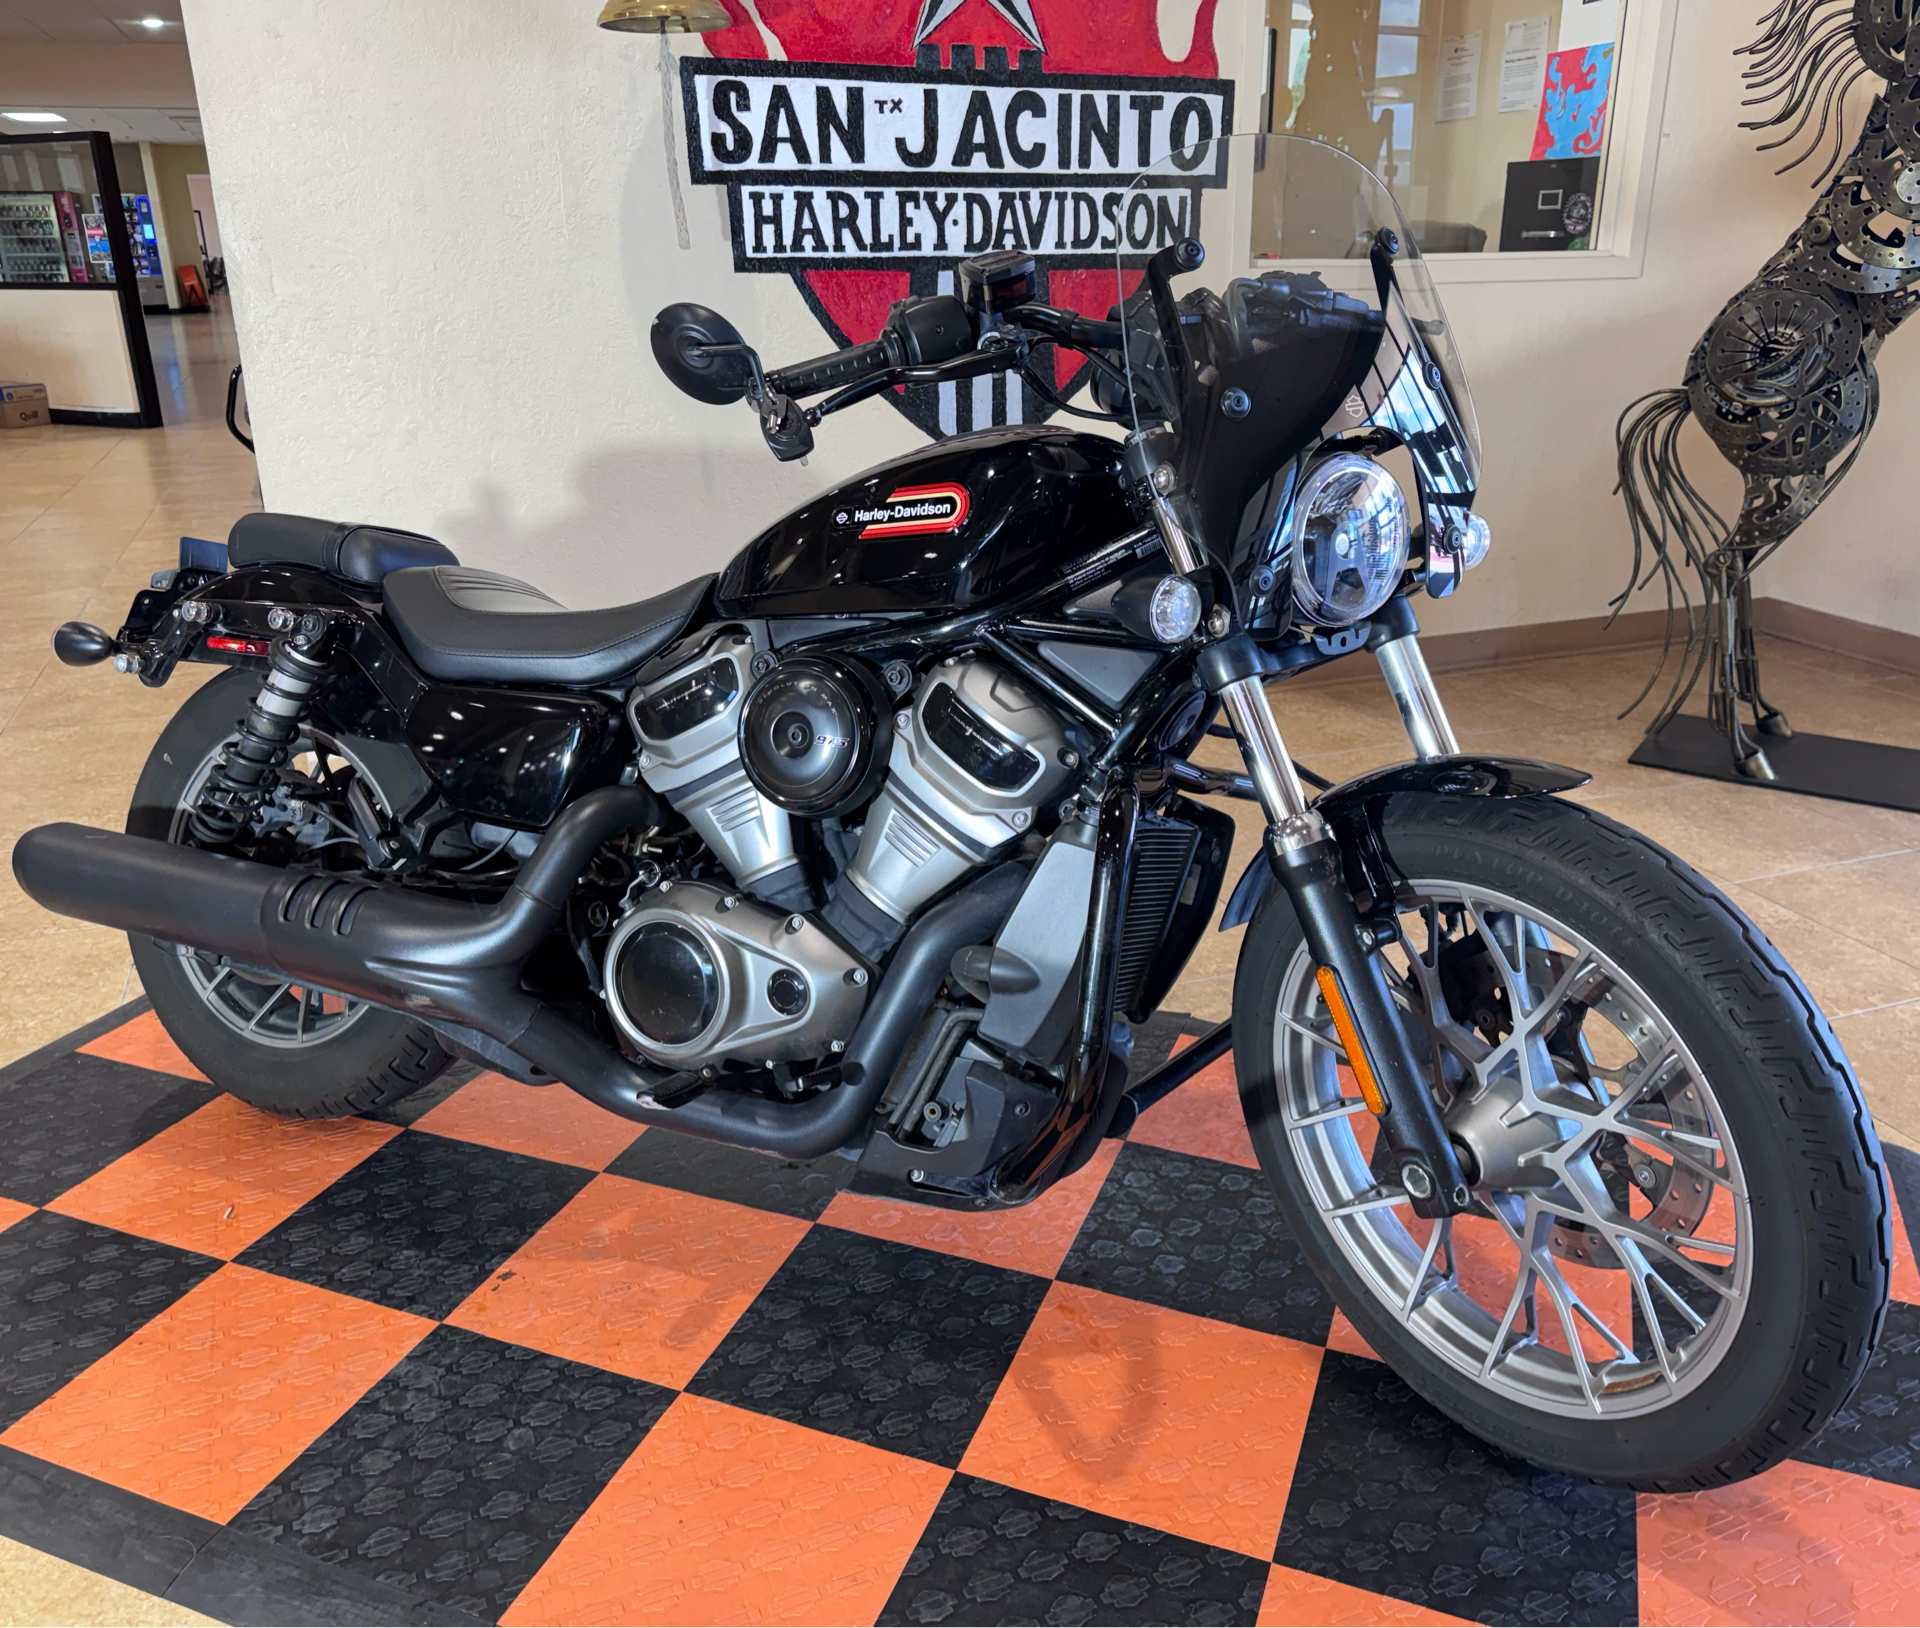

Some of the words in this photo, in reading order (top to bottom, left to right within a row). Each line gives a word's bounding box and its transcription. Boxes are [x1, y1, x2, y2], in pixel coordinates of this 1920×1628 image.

[711, 79, 865, 165] SAN
[875, 99, 903, 115] TX
[895, 88, 1212, 172] JACINTO
[20, 410, 39, 422] Quill
[854, 503, 950, 522] Harley-Davidson
[814, 734, 850, 748] 975
